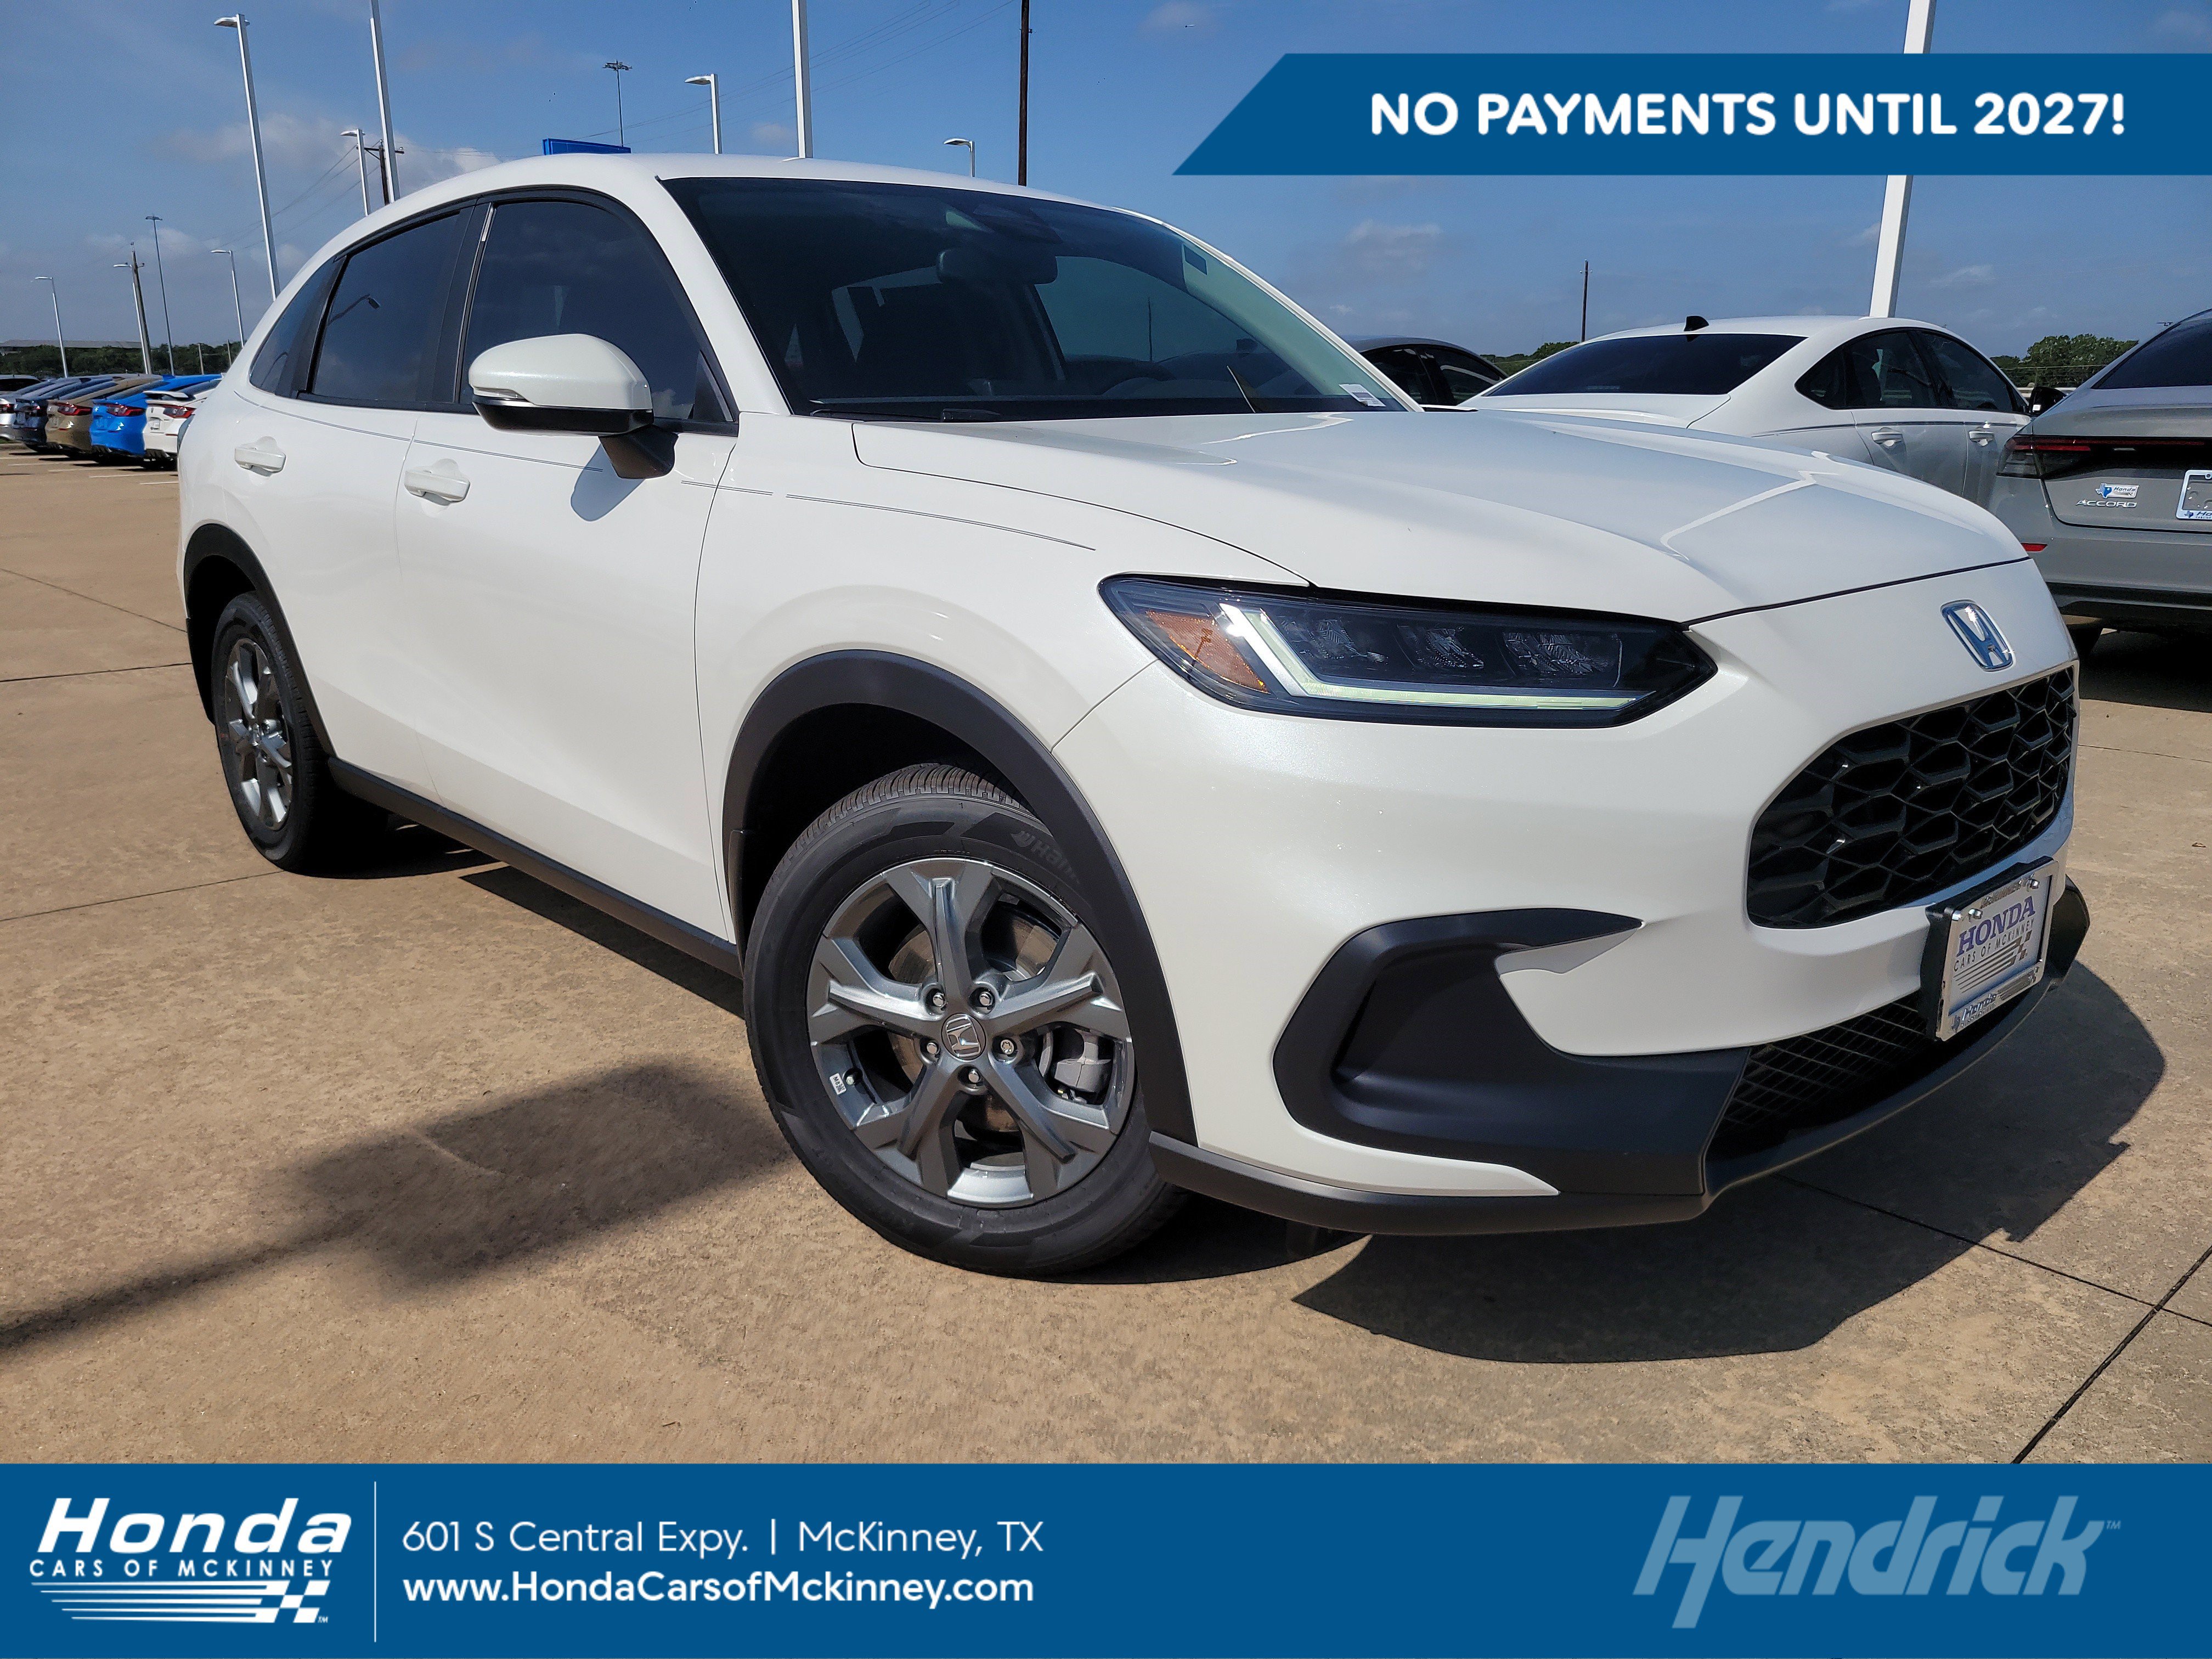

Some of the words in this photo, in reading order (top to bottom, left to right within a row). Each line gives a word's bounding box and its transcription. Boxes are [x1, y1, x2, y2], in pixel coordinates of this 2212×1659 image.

[1954, 951, 1976, 972] CARS
[1980, 943, 1991, 957] OF
[1994, 918, 2035, 950] MCKINNEY
[1956, 895, 2035, 958] HONDA
